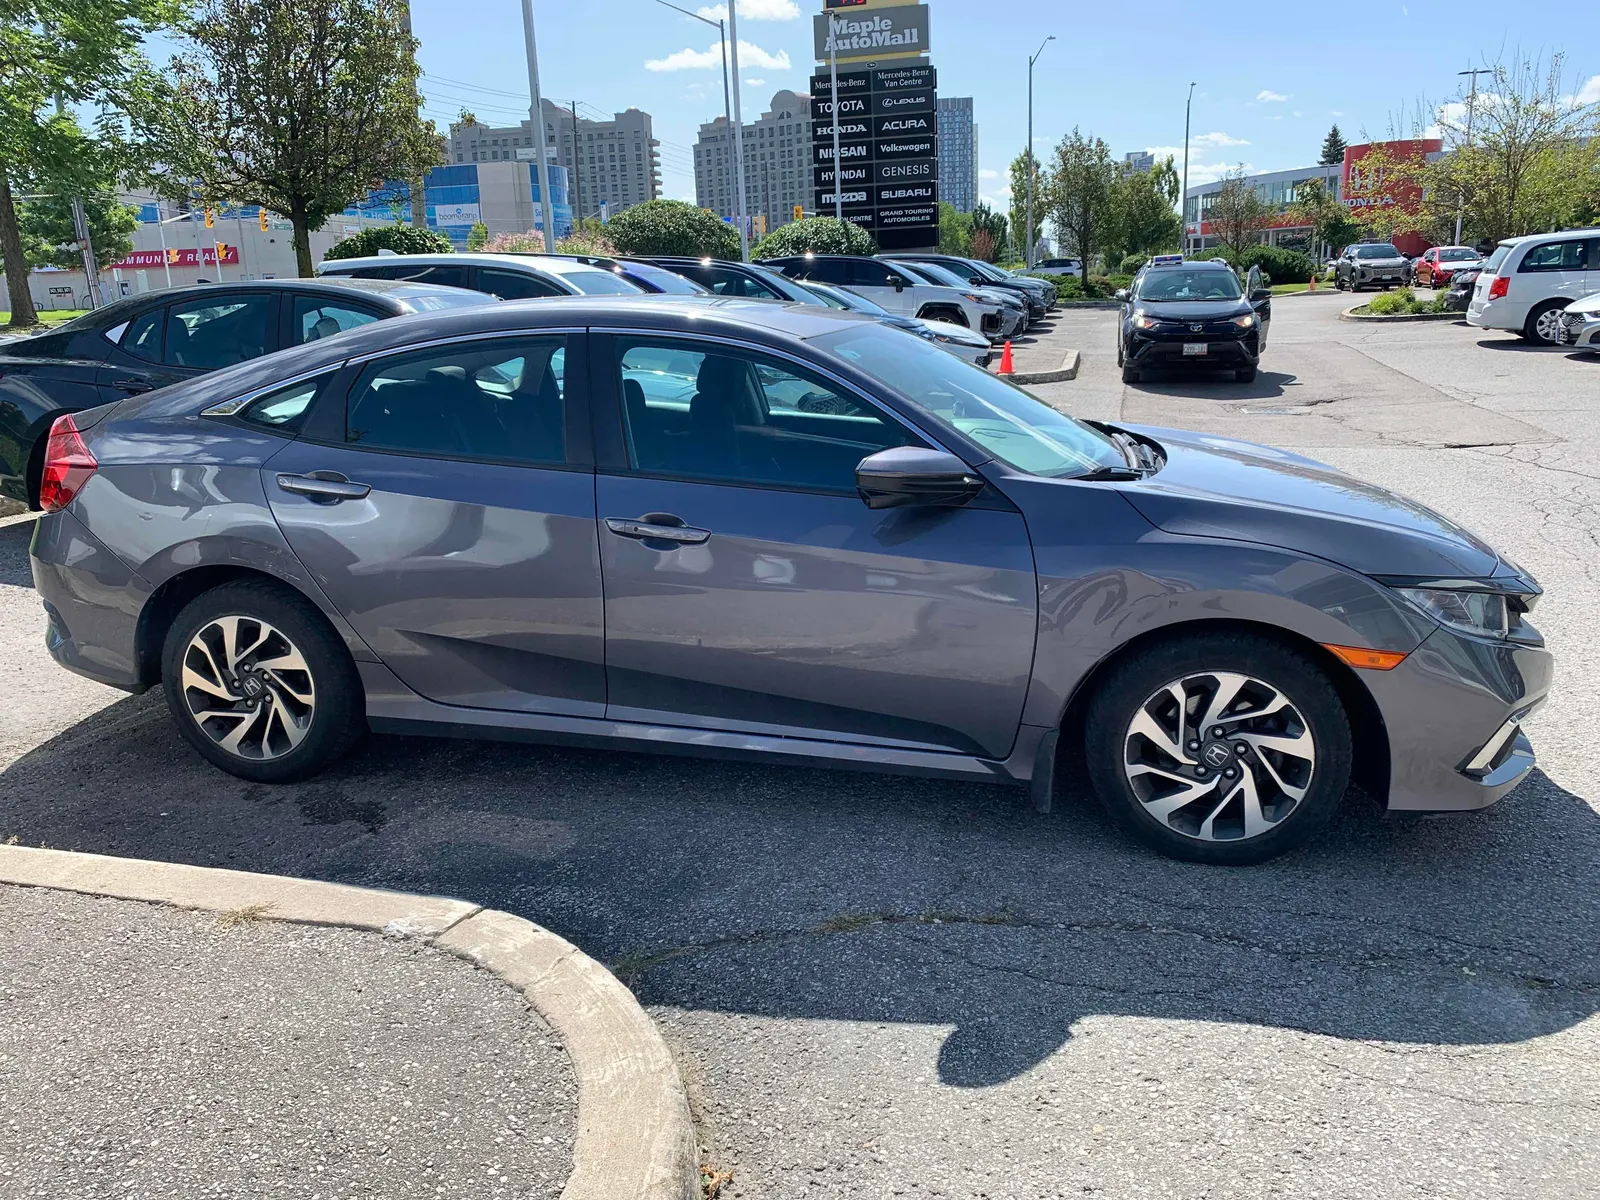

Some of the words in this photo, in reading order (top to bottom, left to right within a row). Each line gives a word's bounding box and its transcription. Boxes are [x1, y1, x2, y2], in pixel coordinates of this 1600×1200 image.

[830, 16, 892, 36] Maple
[824, 28, 919, 52] AutoMall
[877, 69, 930, 80] Mercedes-Benz
[815, 79, 866, 90] Mercdes-Benz
[884, 80, 898, 88] Van
[899, 78, 923, 86] Centre
[893, 97, 926, 105] LEXUS
[817, 100, 865, 114] TOYOTA
[816, 124, 867, 135] HONDA
[882, 119, 927, 131] ACURA
[880, 142, 931, 153] Volkswagen
[821, 169, 866, 181] HYNDAI
[882, 164, 930, 177] GENESIS
[881, 188, 932, 199] SUBARU
[883, 215, 931, 224] AUTOMOBILES
[187, 251, 233, 262] REALY
